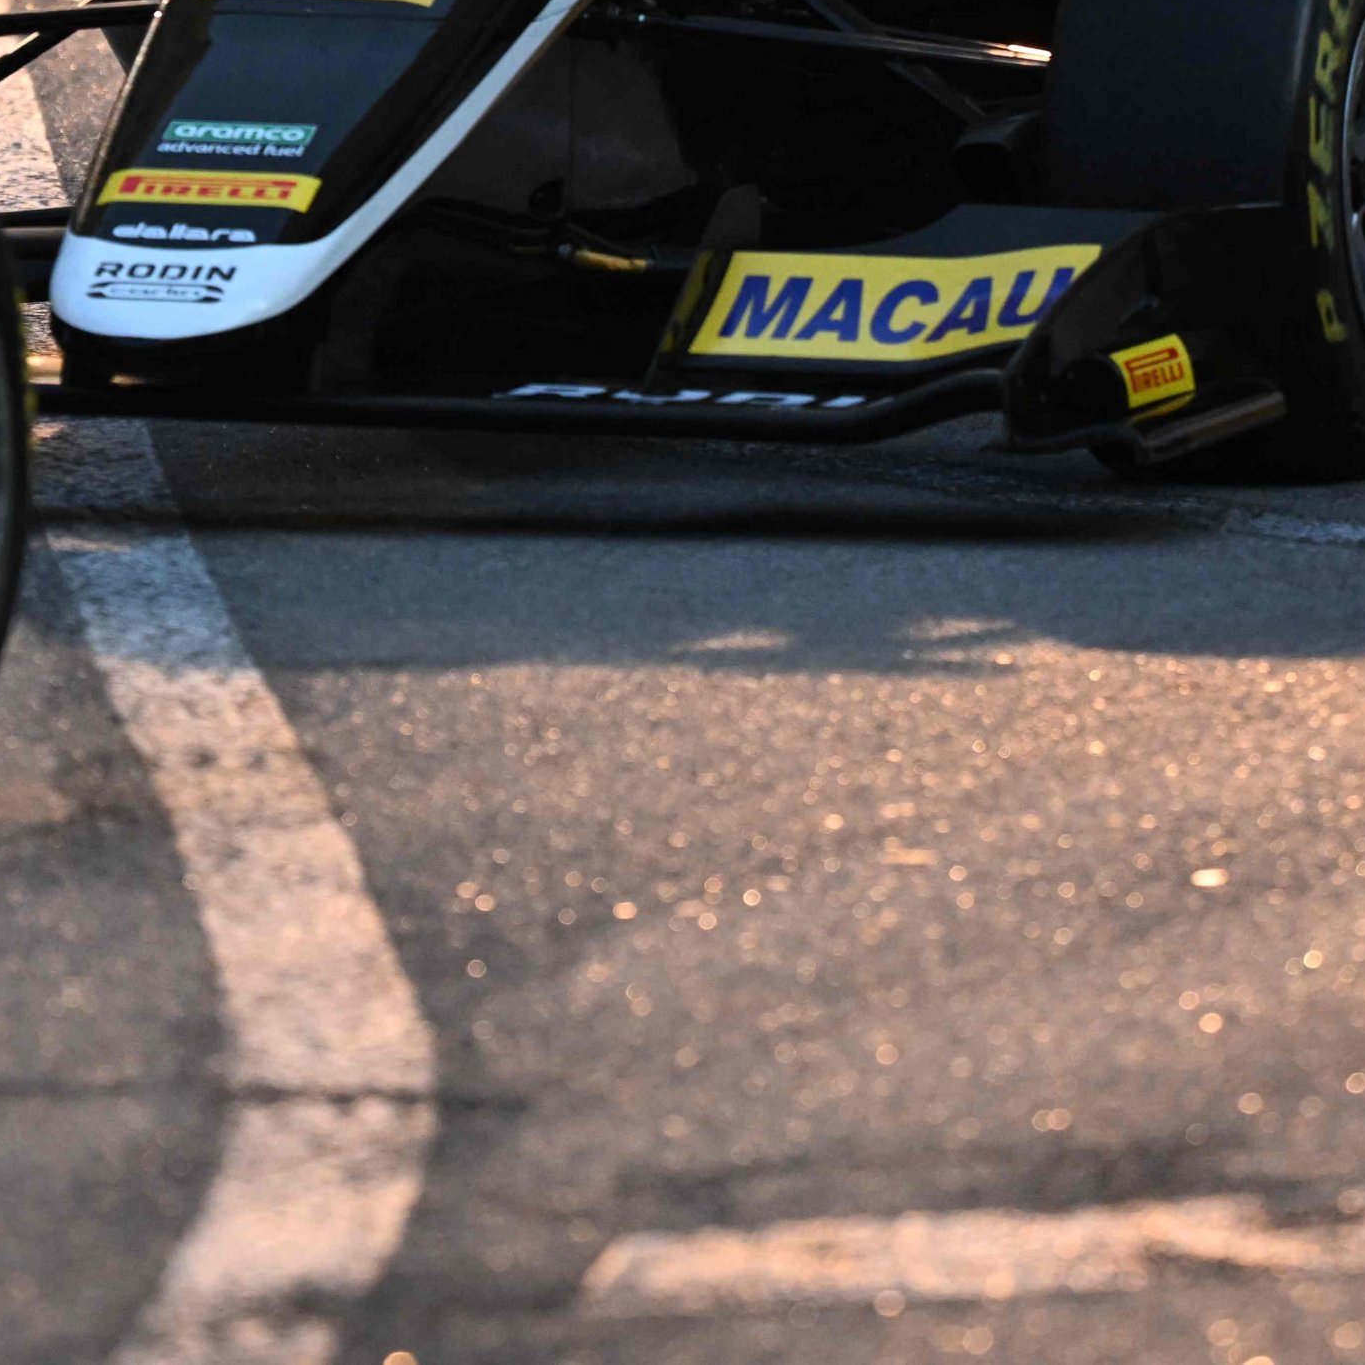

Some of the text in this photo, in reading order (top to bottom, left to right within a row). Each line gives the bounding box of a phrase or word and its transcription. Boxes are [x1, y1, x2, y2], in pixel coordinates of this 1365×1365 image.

[173, 123, 307, 142] aramco
[156, 141, 306, 158] advanced fuel
[118, 175, 298, 200] PIRELLI
[112, 222, 258, 243] dallara
[94, 261, 238, 282] RODIN
[718, 266, 1075, 344] MACAU
[1124, 346, 1184, 395] PIRELLI
